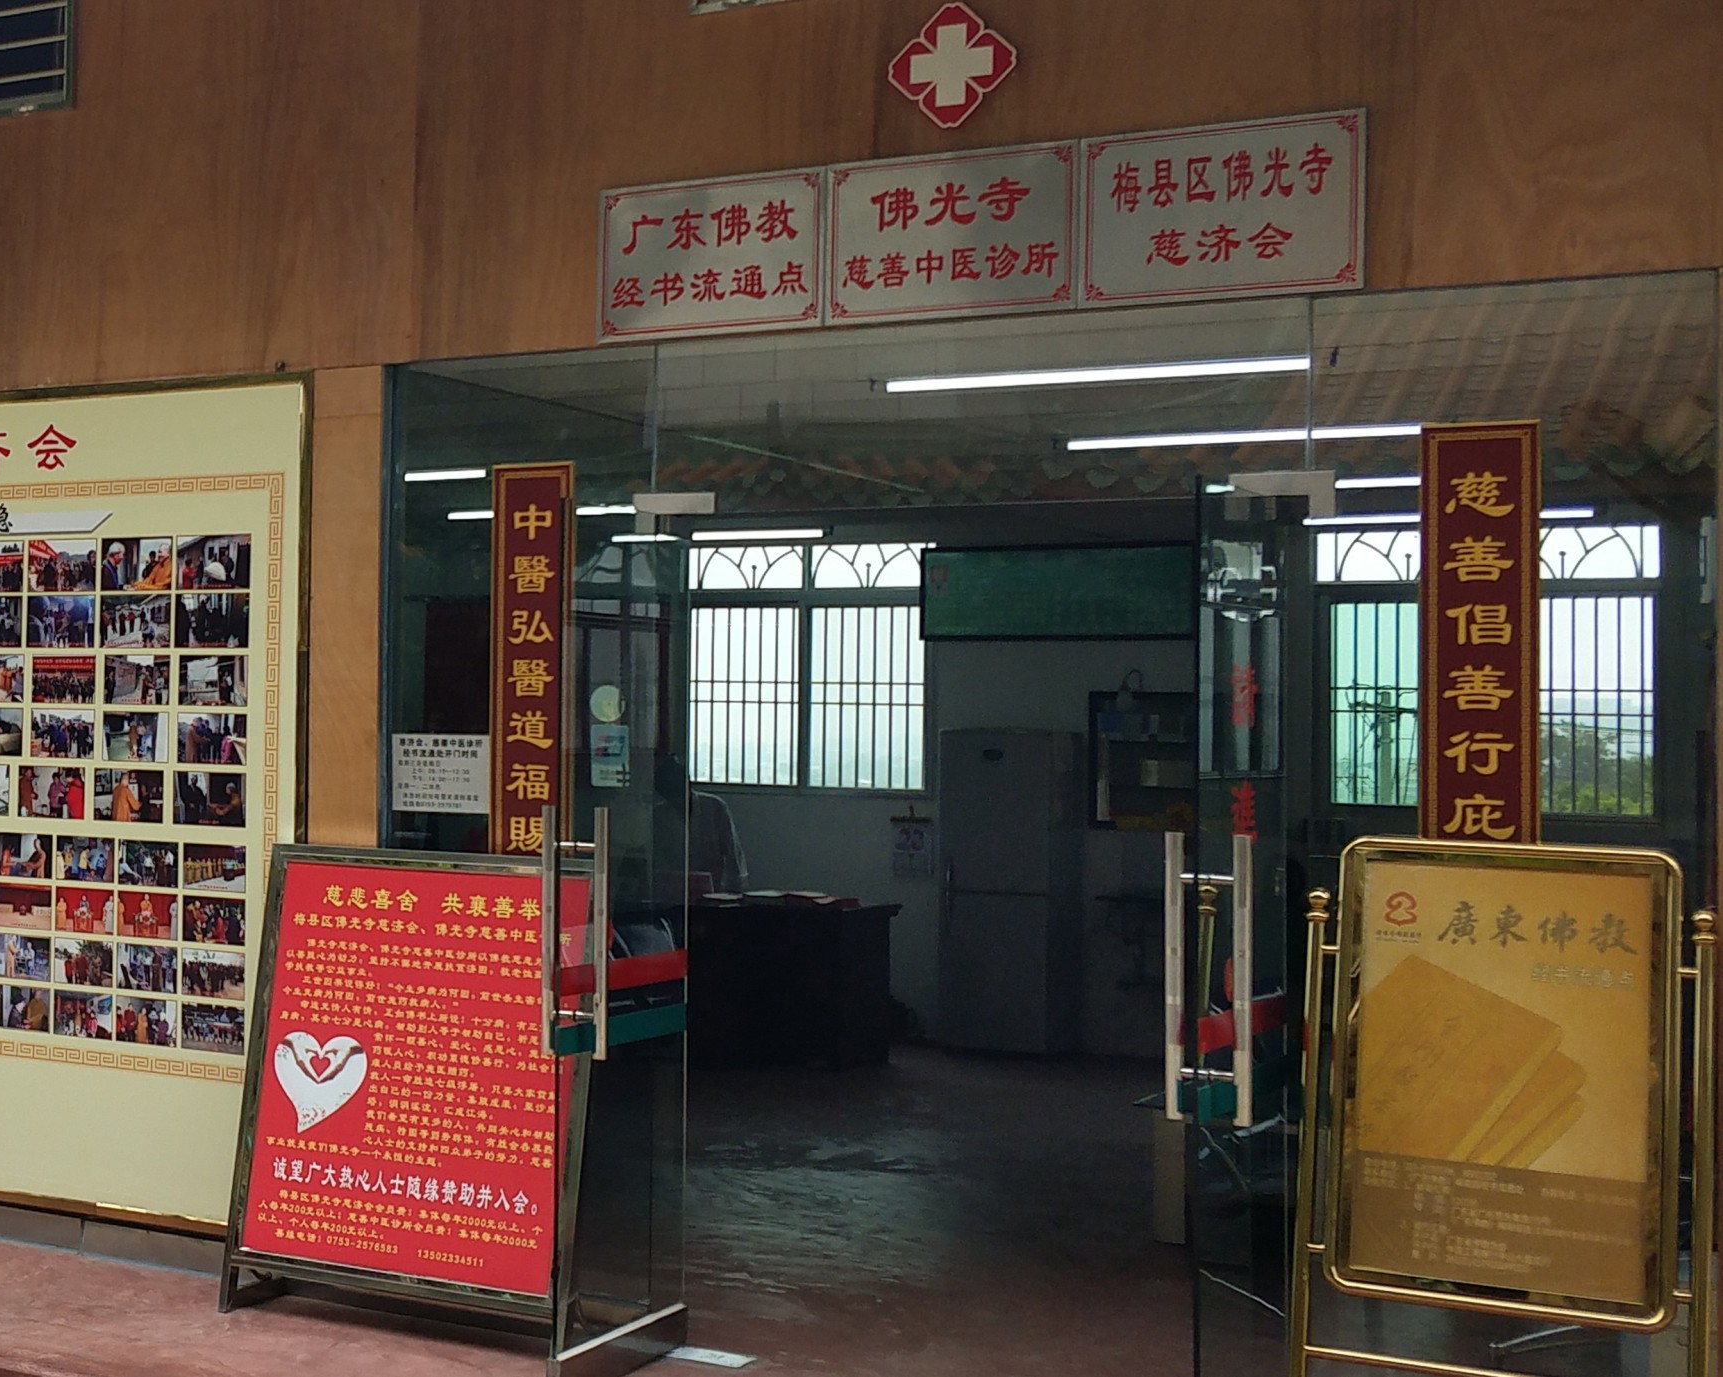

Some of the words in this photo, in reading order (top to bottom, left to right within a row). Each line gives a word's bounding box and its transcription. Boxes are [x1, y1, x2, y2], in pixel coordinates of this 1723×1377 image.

[871, 176, 1032, 233] 佛光寺
[1111, 142, 1334, 215] 梅县区佛光寺
[622, 199, 798, 255] 广东佛教
[1147, 222, 1294, 267] 慈济会
[610, 261, 808, 309] 经书流通点
[841, 243, 1059, 290] 慈善中医诊所
[506, 503, 555, 853] 中醫弘醫道福賜
[1443, 471, 1516, 841] 慈善倡善行庇
[322, 883, 419, 913] 慈悲喜舍
[439, 891, 543, 921] 共襄善举
[1437, 900, 1638, 955] 廣東佛教
[271, 1154, 539, 1217] 诚望广大热心人士随缘赞助并入会。
